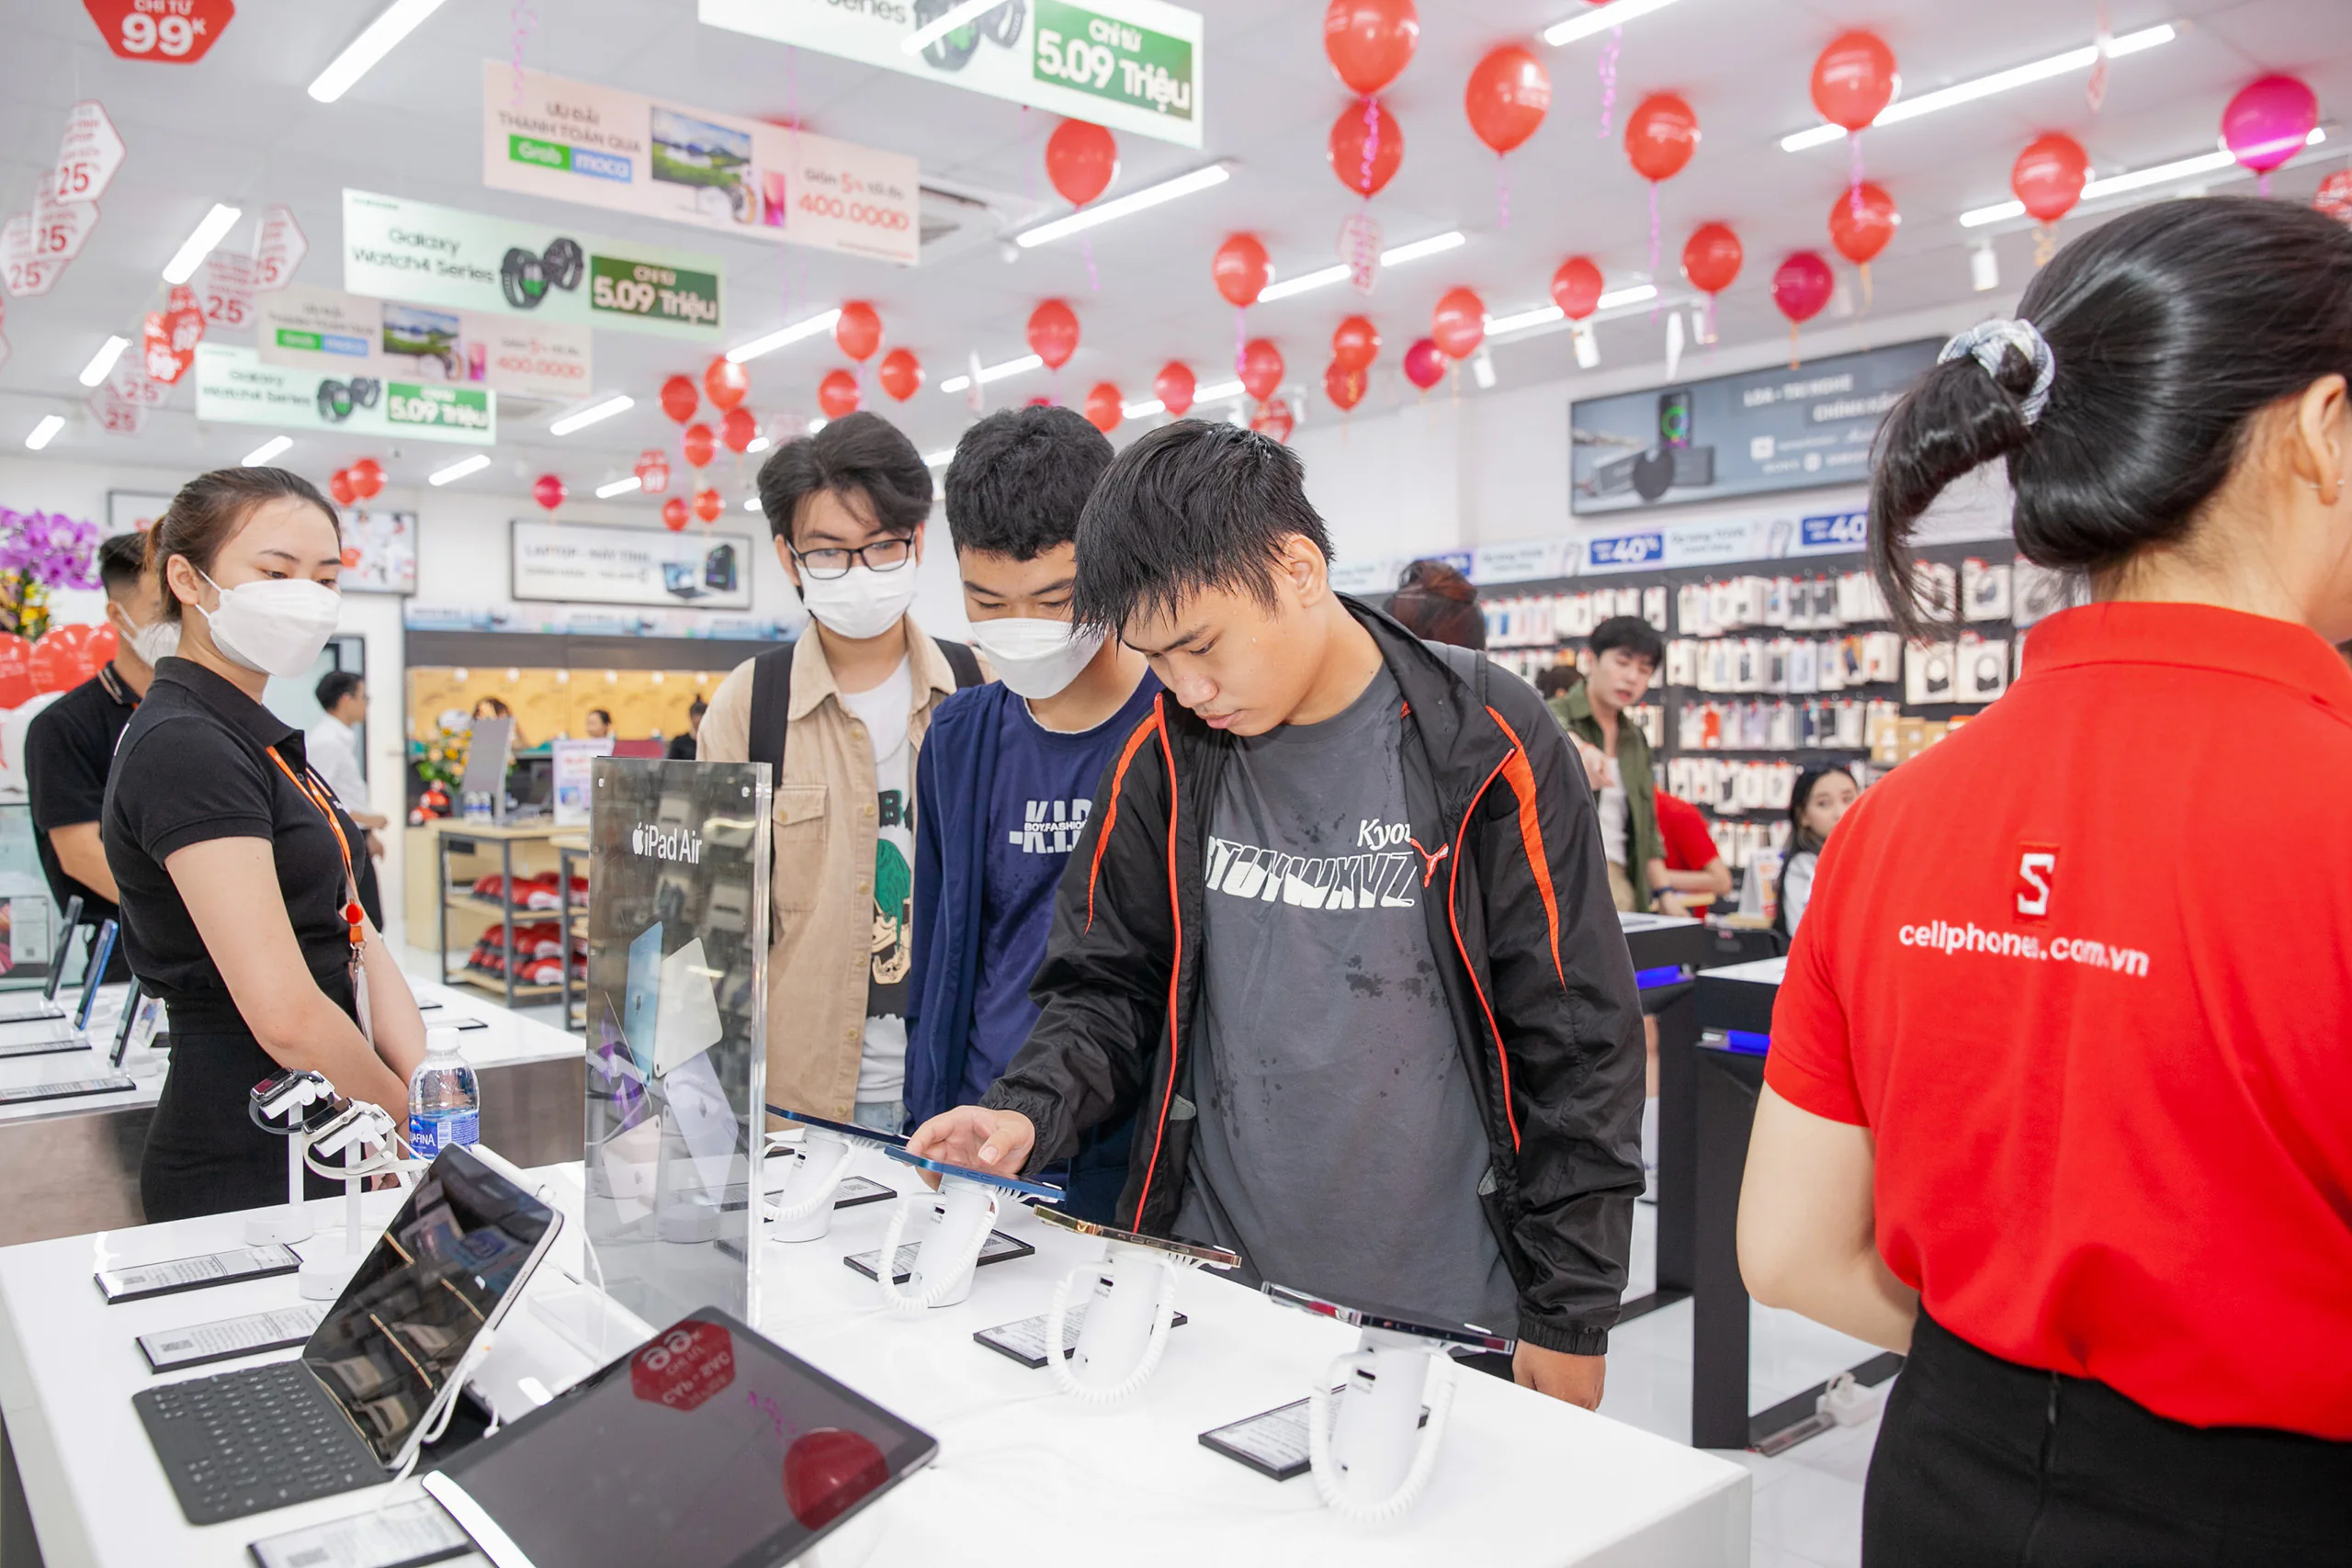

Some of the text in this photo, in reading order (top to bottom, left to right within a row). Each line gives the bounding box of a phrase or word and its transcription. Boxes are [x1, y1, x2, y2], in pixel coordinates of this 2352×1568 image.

[1037, 28, 1191, 114] 5.09 Triệu
[518, 141, 629, 178] Grab moca
[388, 229, 460, 258] Galaxy
[353, 246, 497, 284] Watch4 Series
[593, 274, 718, 324] 5.09 Triệu
[644, 824, 703, 865] iPad Air
[2017, 852, 2056, 916] S
